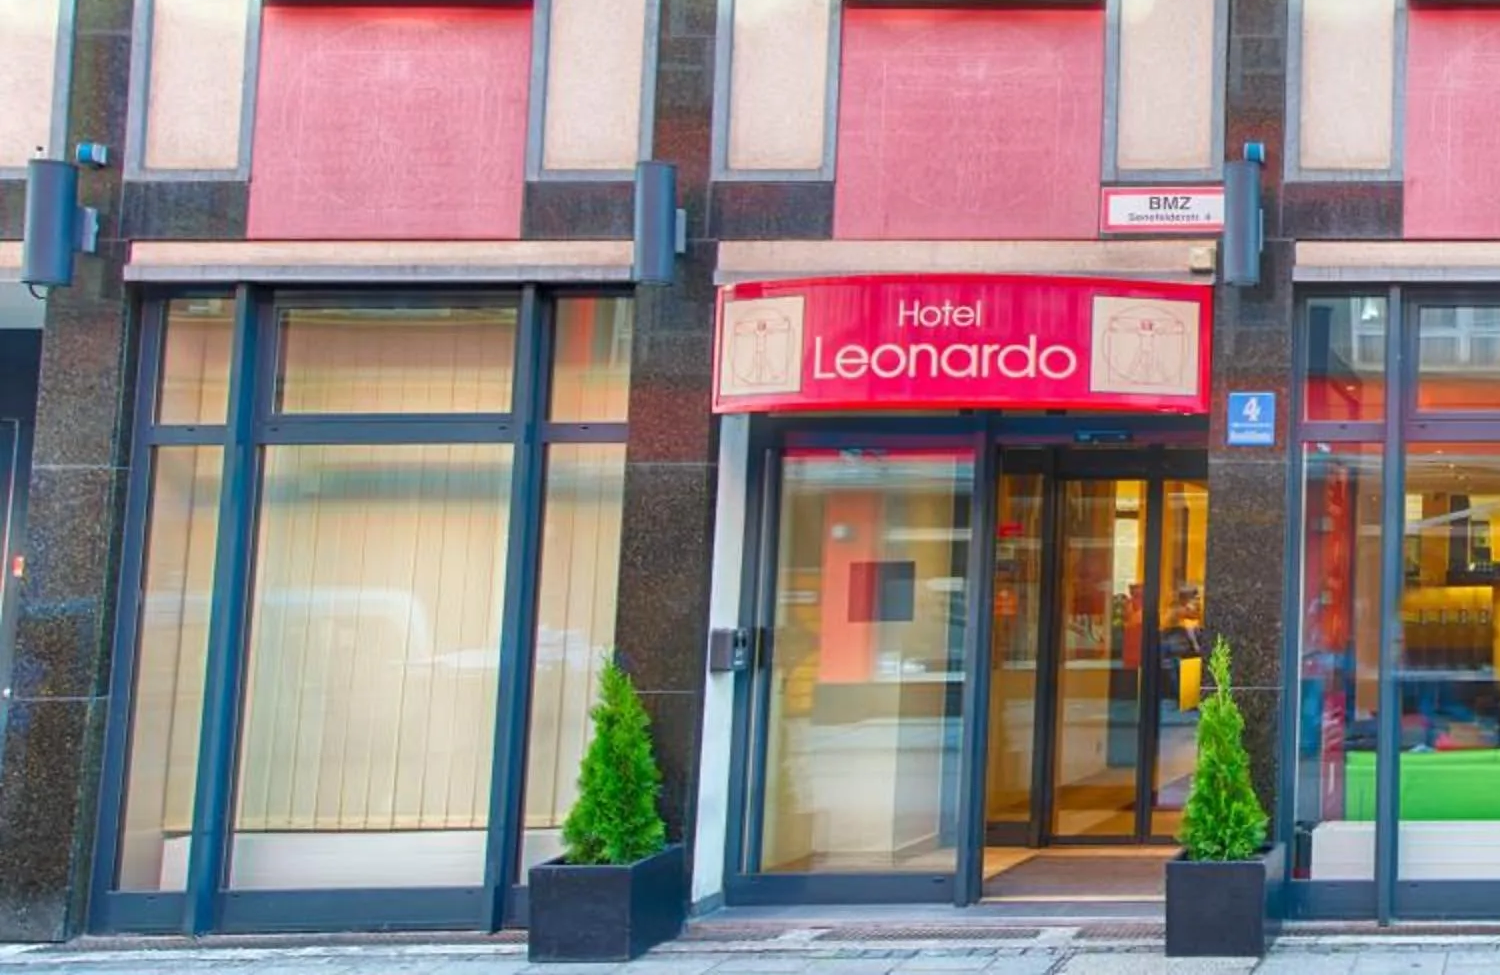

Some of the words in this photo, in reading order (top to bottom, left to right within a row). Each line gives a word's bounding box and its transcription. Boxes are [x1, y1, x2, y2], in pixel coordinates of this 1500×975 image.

[1149, 196, 1192, 210] BMZ
[899, 299, 982, 327] Hotel
[813, 334, 1078, 380] Leonardo
[1242, 396, 1261, 422] 4
